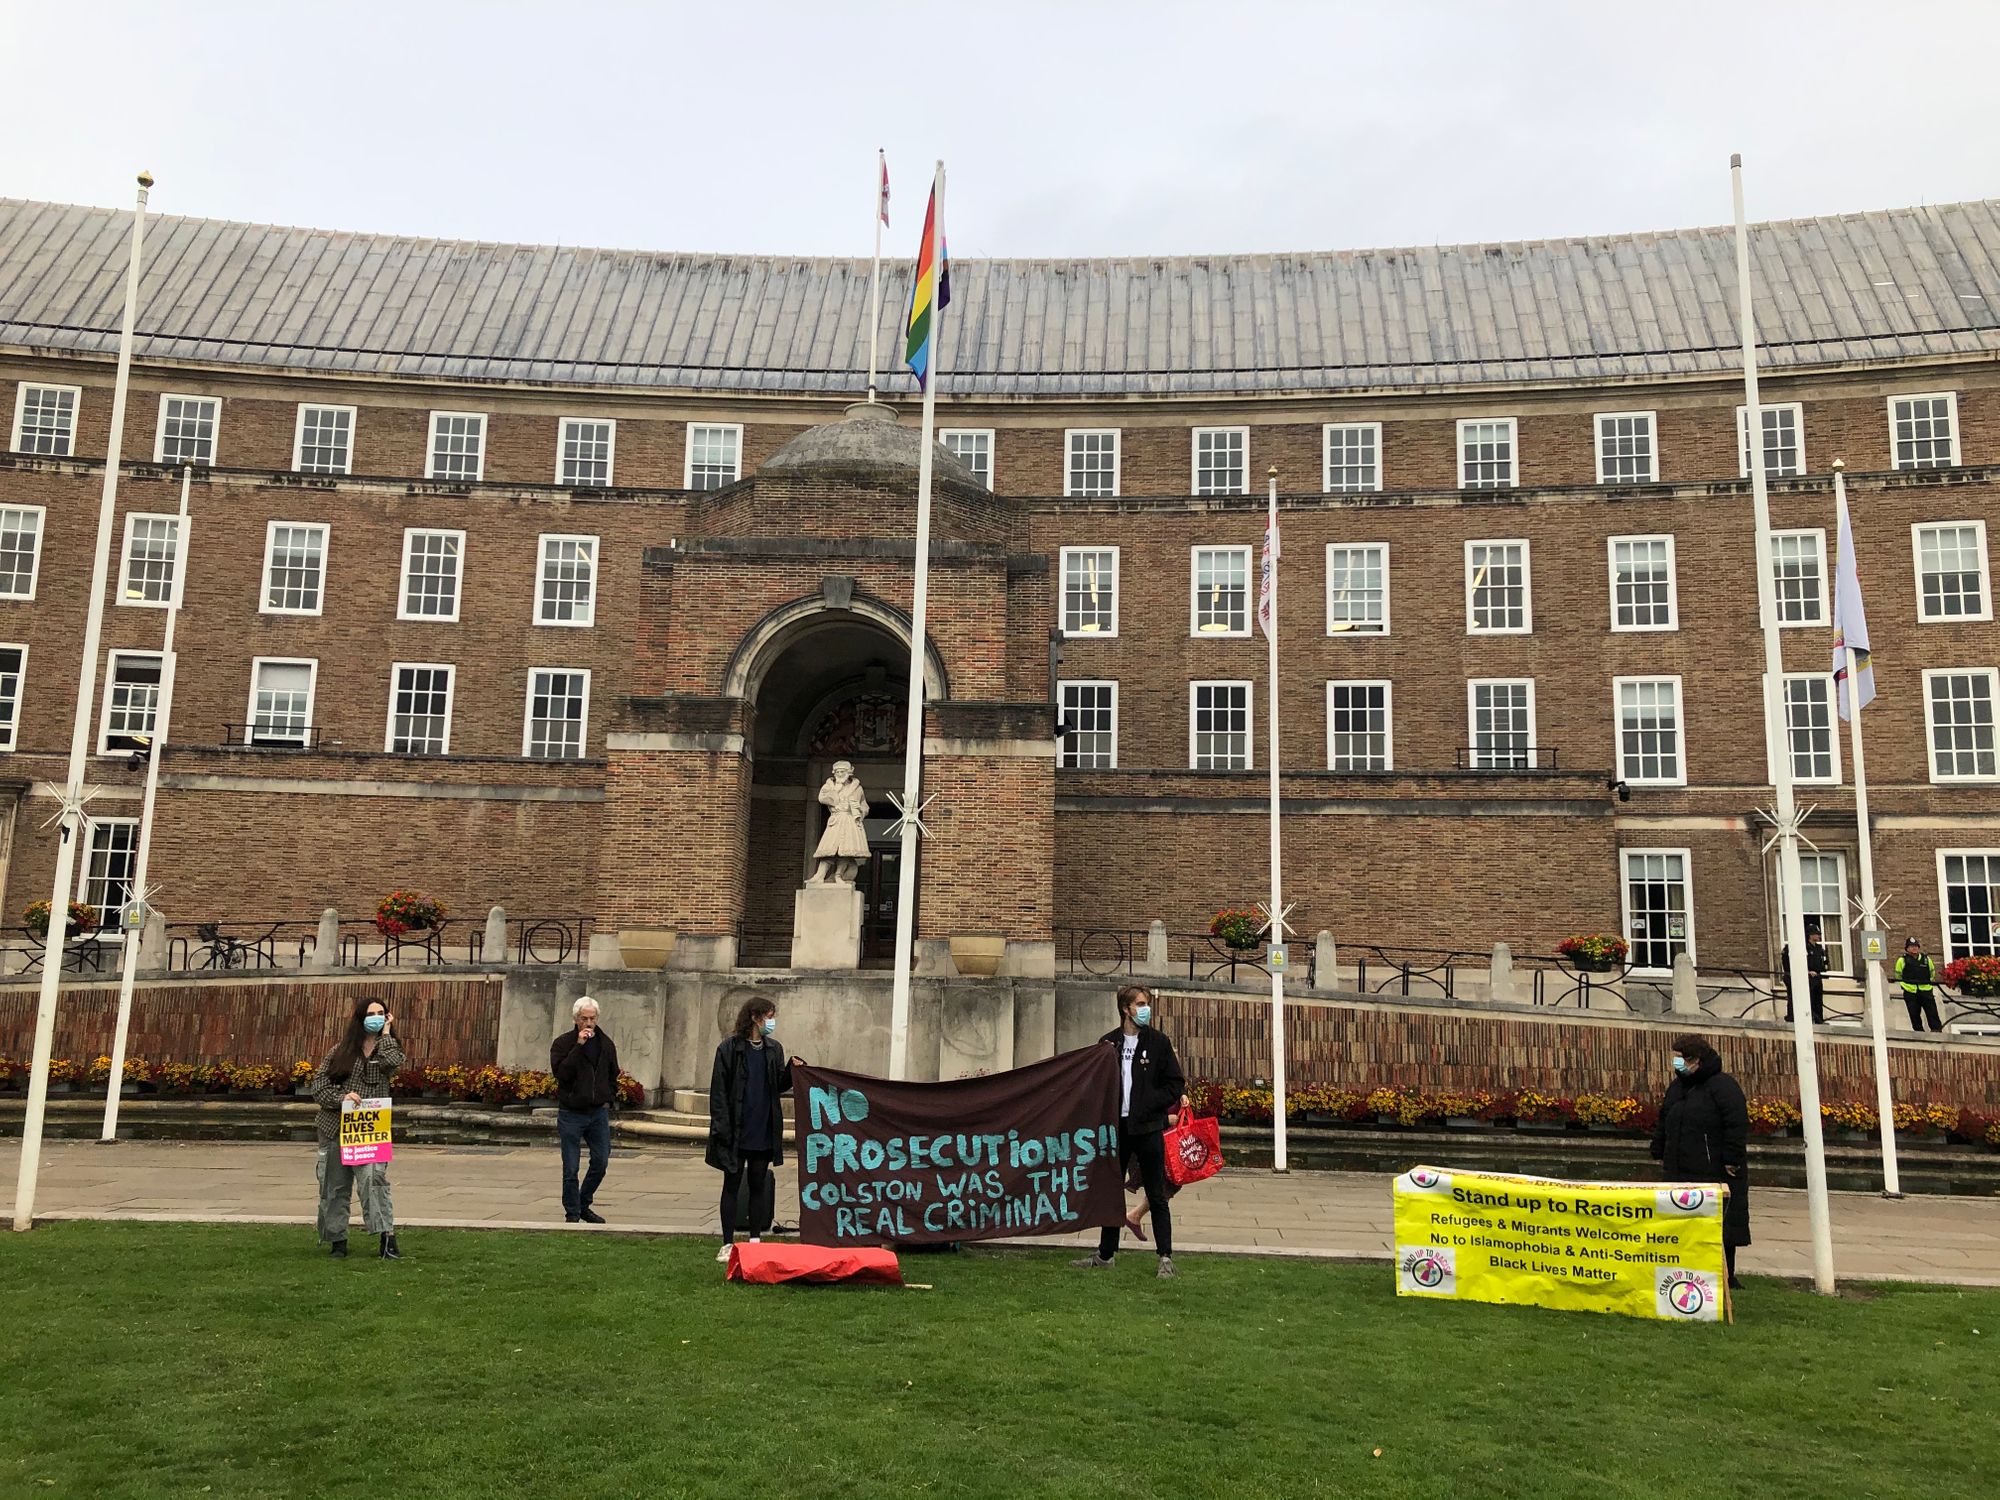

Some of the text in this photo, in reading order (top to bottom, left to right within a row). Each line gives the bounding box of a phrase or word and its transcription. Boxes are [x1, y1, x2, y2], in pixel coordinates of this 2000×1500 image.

[344, 1110, 380, 1123] BLACK
[809, 1085, 870, 1131] NO
[343, 1122, 375, 1133] LIVES
[343, 1132, 388, 1144] MATTER
[355, 1145, 378, 1154] justice
[355, 1153, 375, 1161] peace
[802, 1165, 1090, 1210] COLSTON WAS THE
[1452, 1187, 1654, 1220] Stand up to Racism
[836, 1205, 916, 1239] REAL
[1431, 1213, 1680, 1245] Refugees & Migrants Welcome Here
[1426, 1249, 1434, 1257] TO
[1431, 1233, 1681, 1264] No to Islamophobia & Anti-Semitism
[1489, 1255, 1618, 1281] Black Lives Matter
[1660, 1275, 1675, 1296] STAND
[1673, 1271, 1683, 1281] UP
[1685, 1271, 1694, 1281] TO
